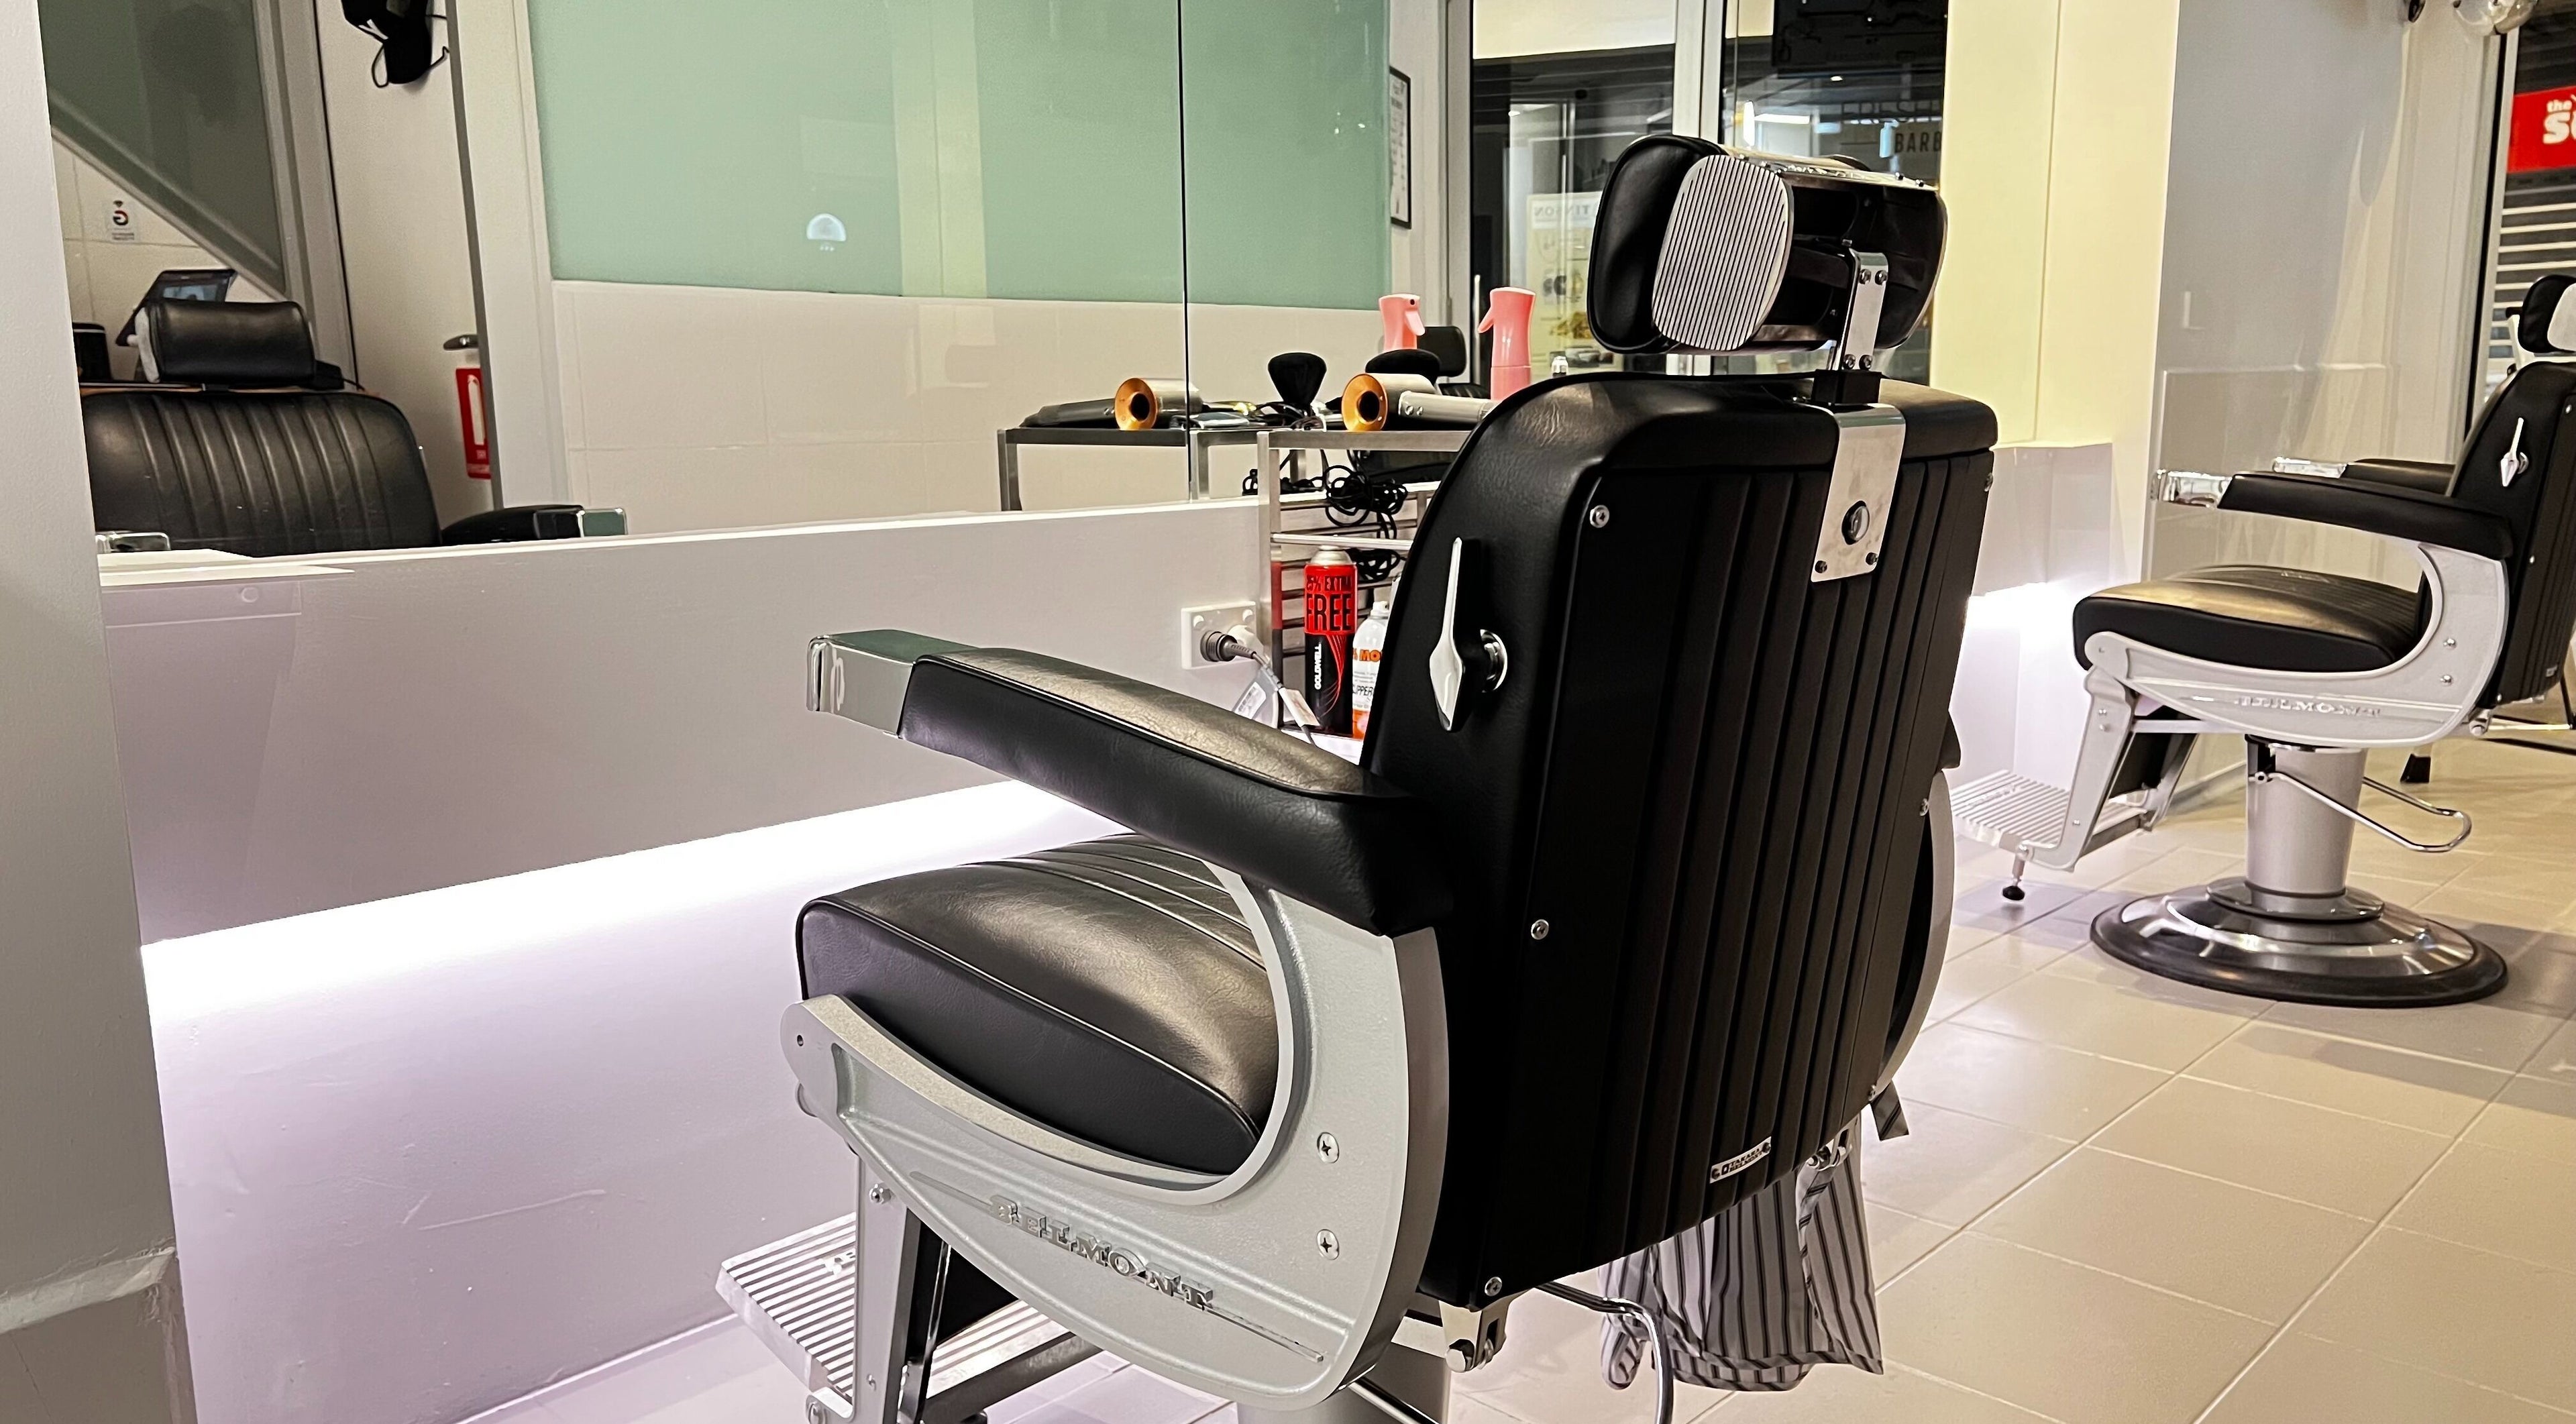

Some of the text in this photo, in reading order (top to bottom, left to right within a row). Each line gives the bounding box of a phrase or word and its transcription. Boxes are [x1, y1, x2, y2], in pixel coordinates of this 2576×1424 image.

[2546, 99, 2573, 113] the
[2542, 110, 2576, 144] S
[1306, 593, 1353, 631] FREE
[989, 1195, 1214, 1312] BELMONT
